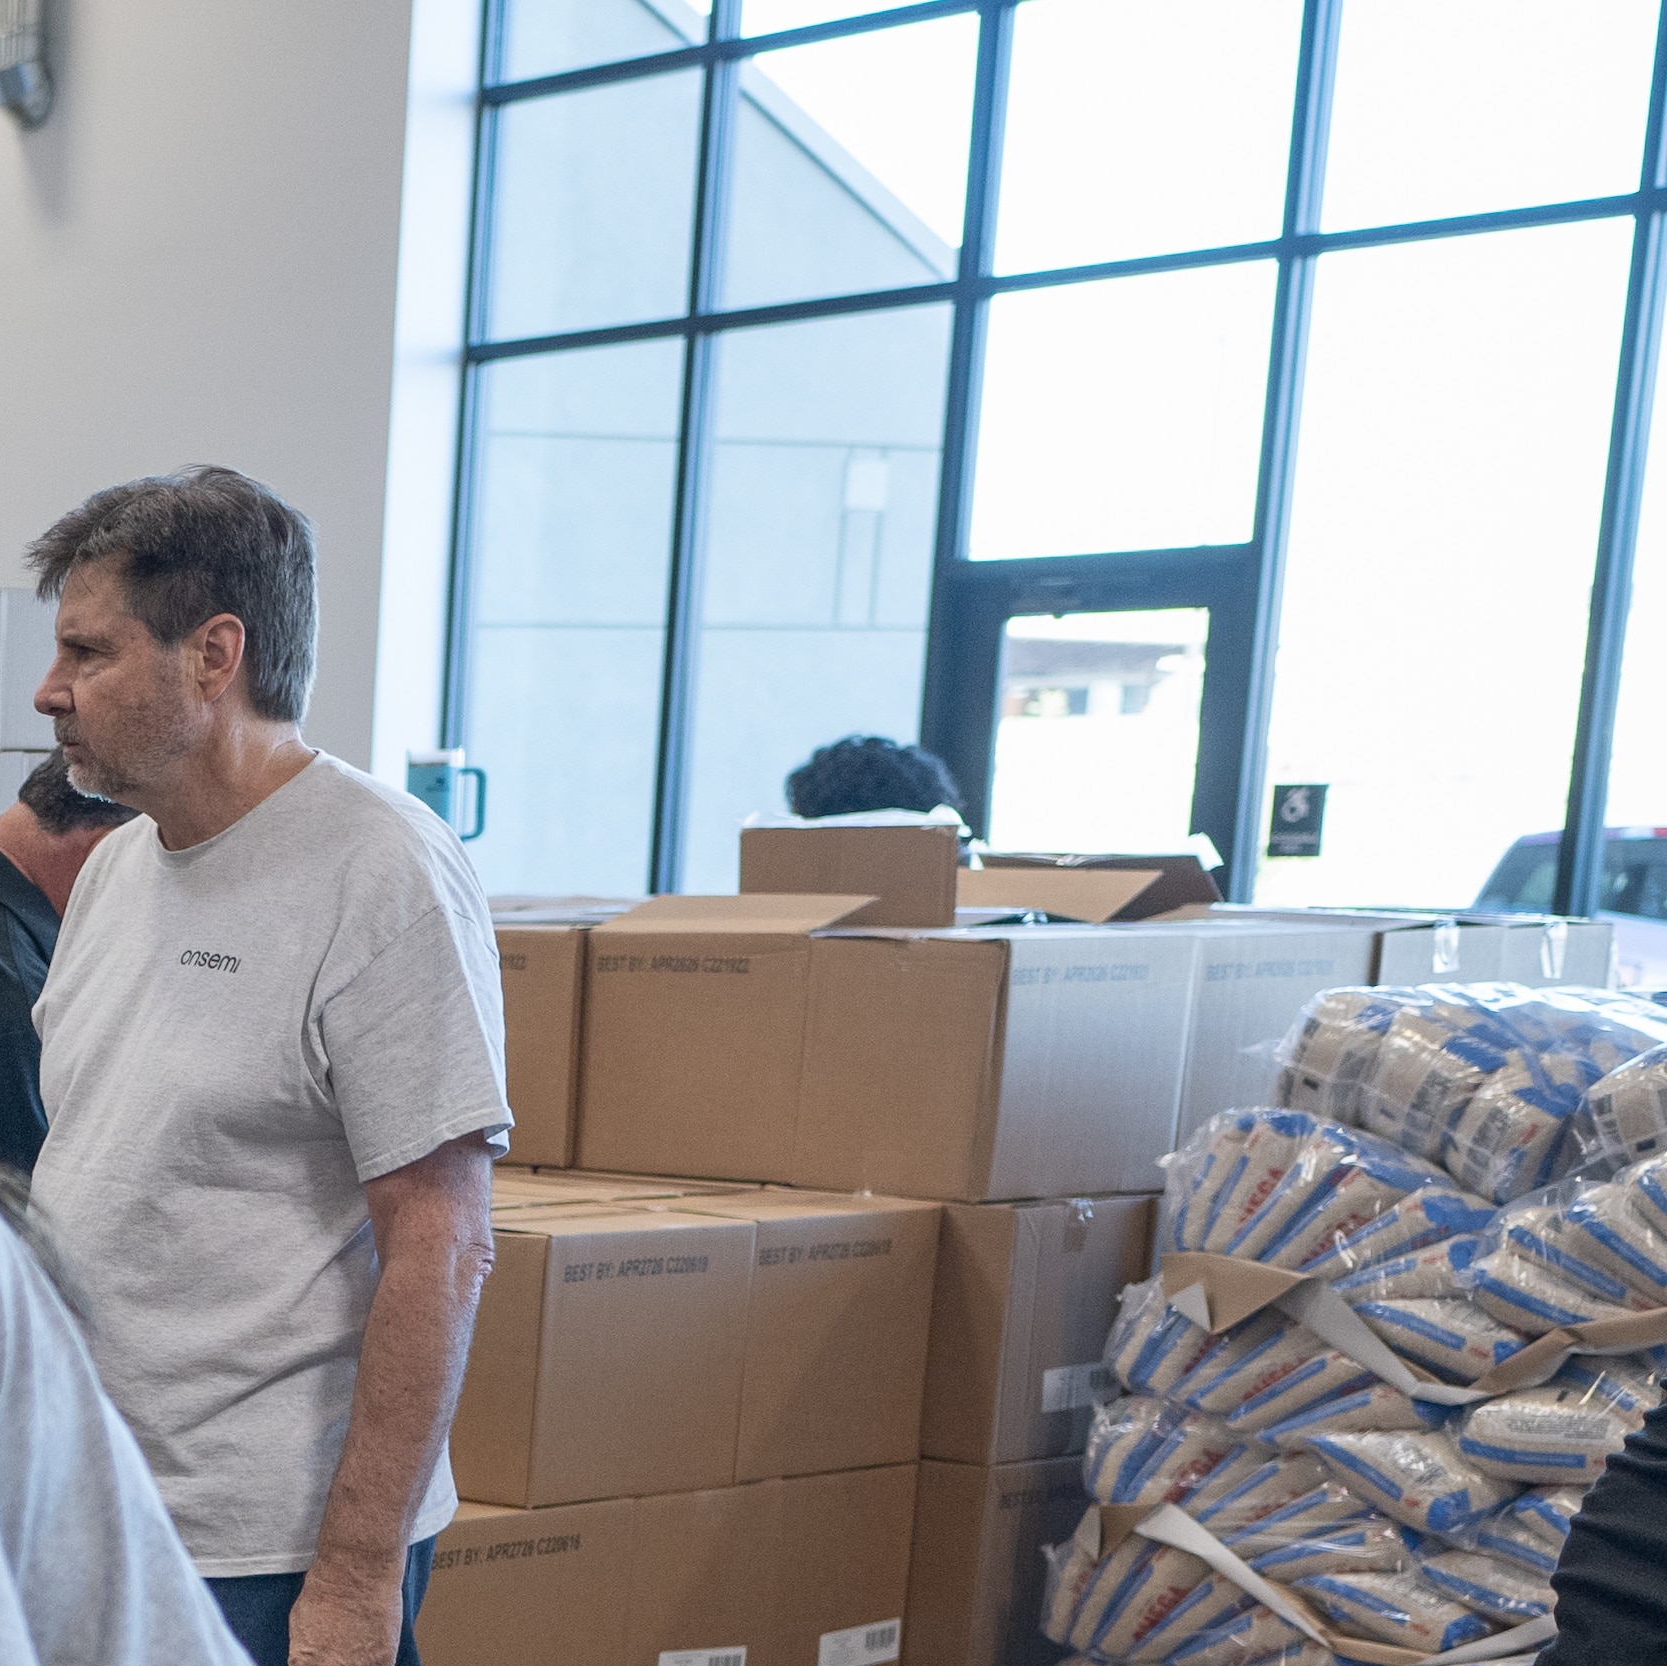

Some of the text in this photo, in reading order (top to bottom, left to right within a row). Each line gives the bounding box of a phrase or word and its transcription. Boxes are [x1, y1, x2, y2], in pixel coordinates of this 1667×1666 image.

[180, 950, 242, 974] onsemi
[758, 1246, 788, 1267] BEST
[564, 1261, 593, 1284] BEST
